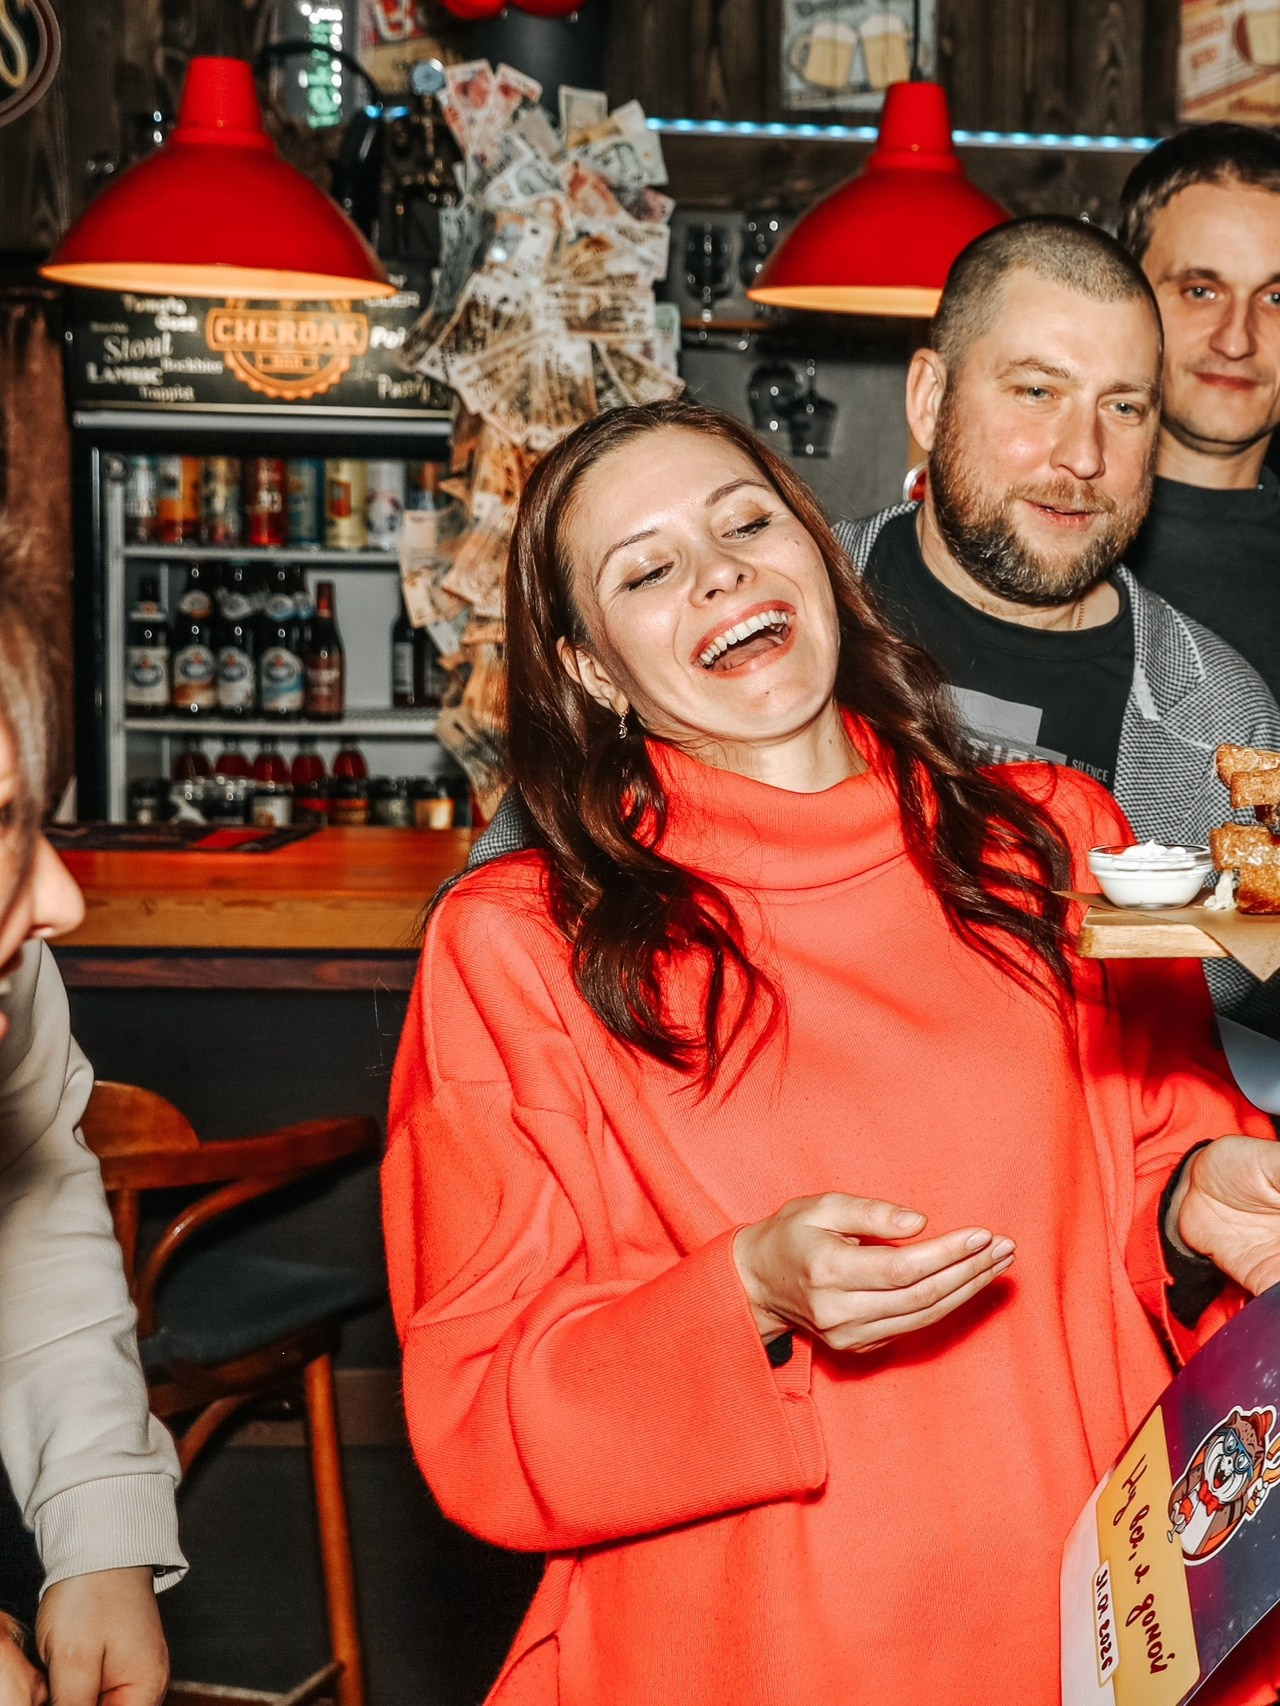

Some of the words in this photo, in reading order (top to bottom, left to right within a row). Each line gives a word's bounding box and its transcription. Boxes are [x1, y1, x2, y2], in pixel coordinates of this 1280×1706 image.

[103, 330, 174, 364] Stout
[213, 317, 359, 347] CHERDAK
[1112, 1453, 1149, 1526] Ну
[1125, 1593, 1176, 1675] домой
